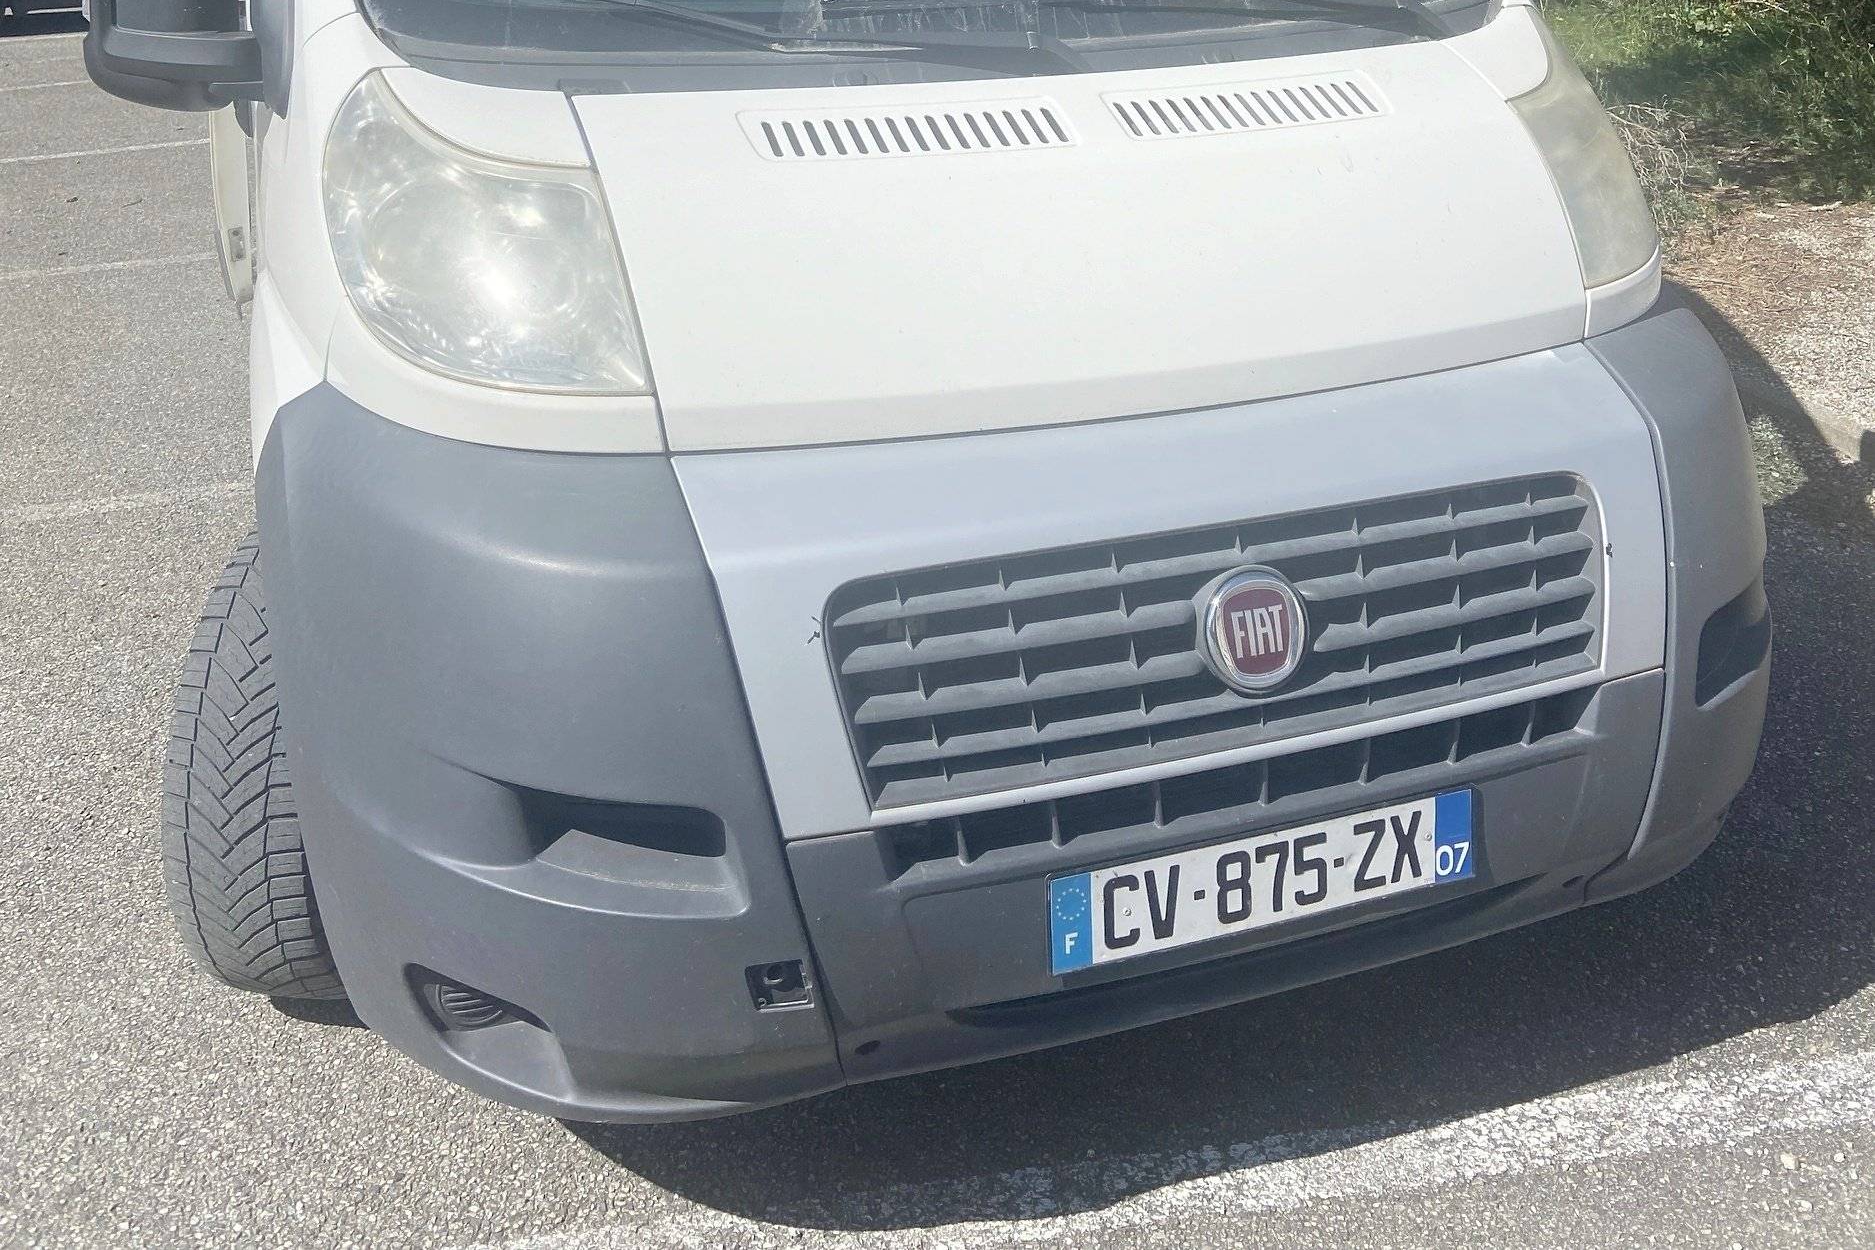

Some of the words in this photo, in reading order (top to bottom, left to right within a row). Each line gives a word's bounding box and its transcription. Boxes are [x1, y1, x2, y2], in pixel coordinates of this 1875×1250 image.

[1230, 603, 1285, 659] FIAT
[1102, 810, 1423, 950] CV-875-ZX
[1435, 841, 1470, 877] 07
[1064, 931, 1079, 955] F
